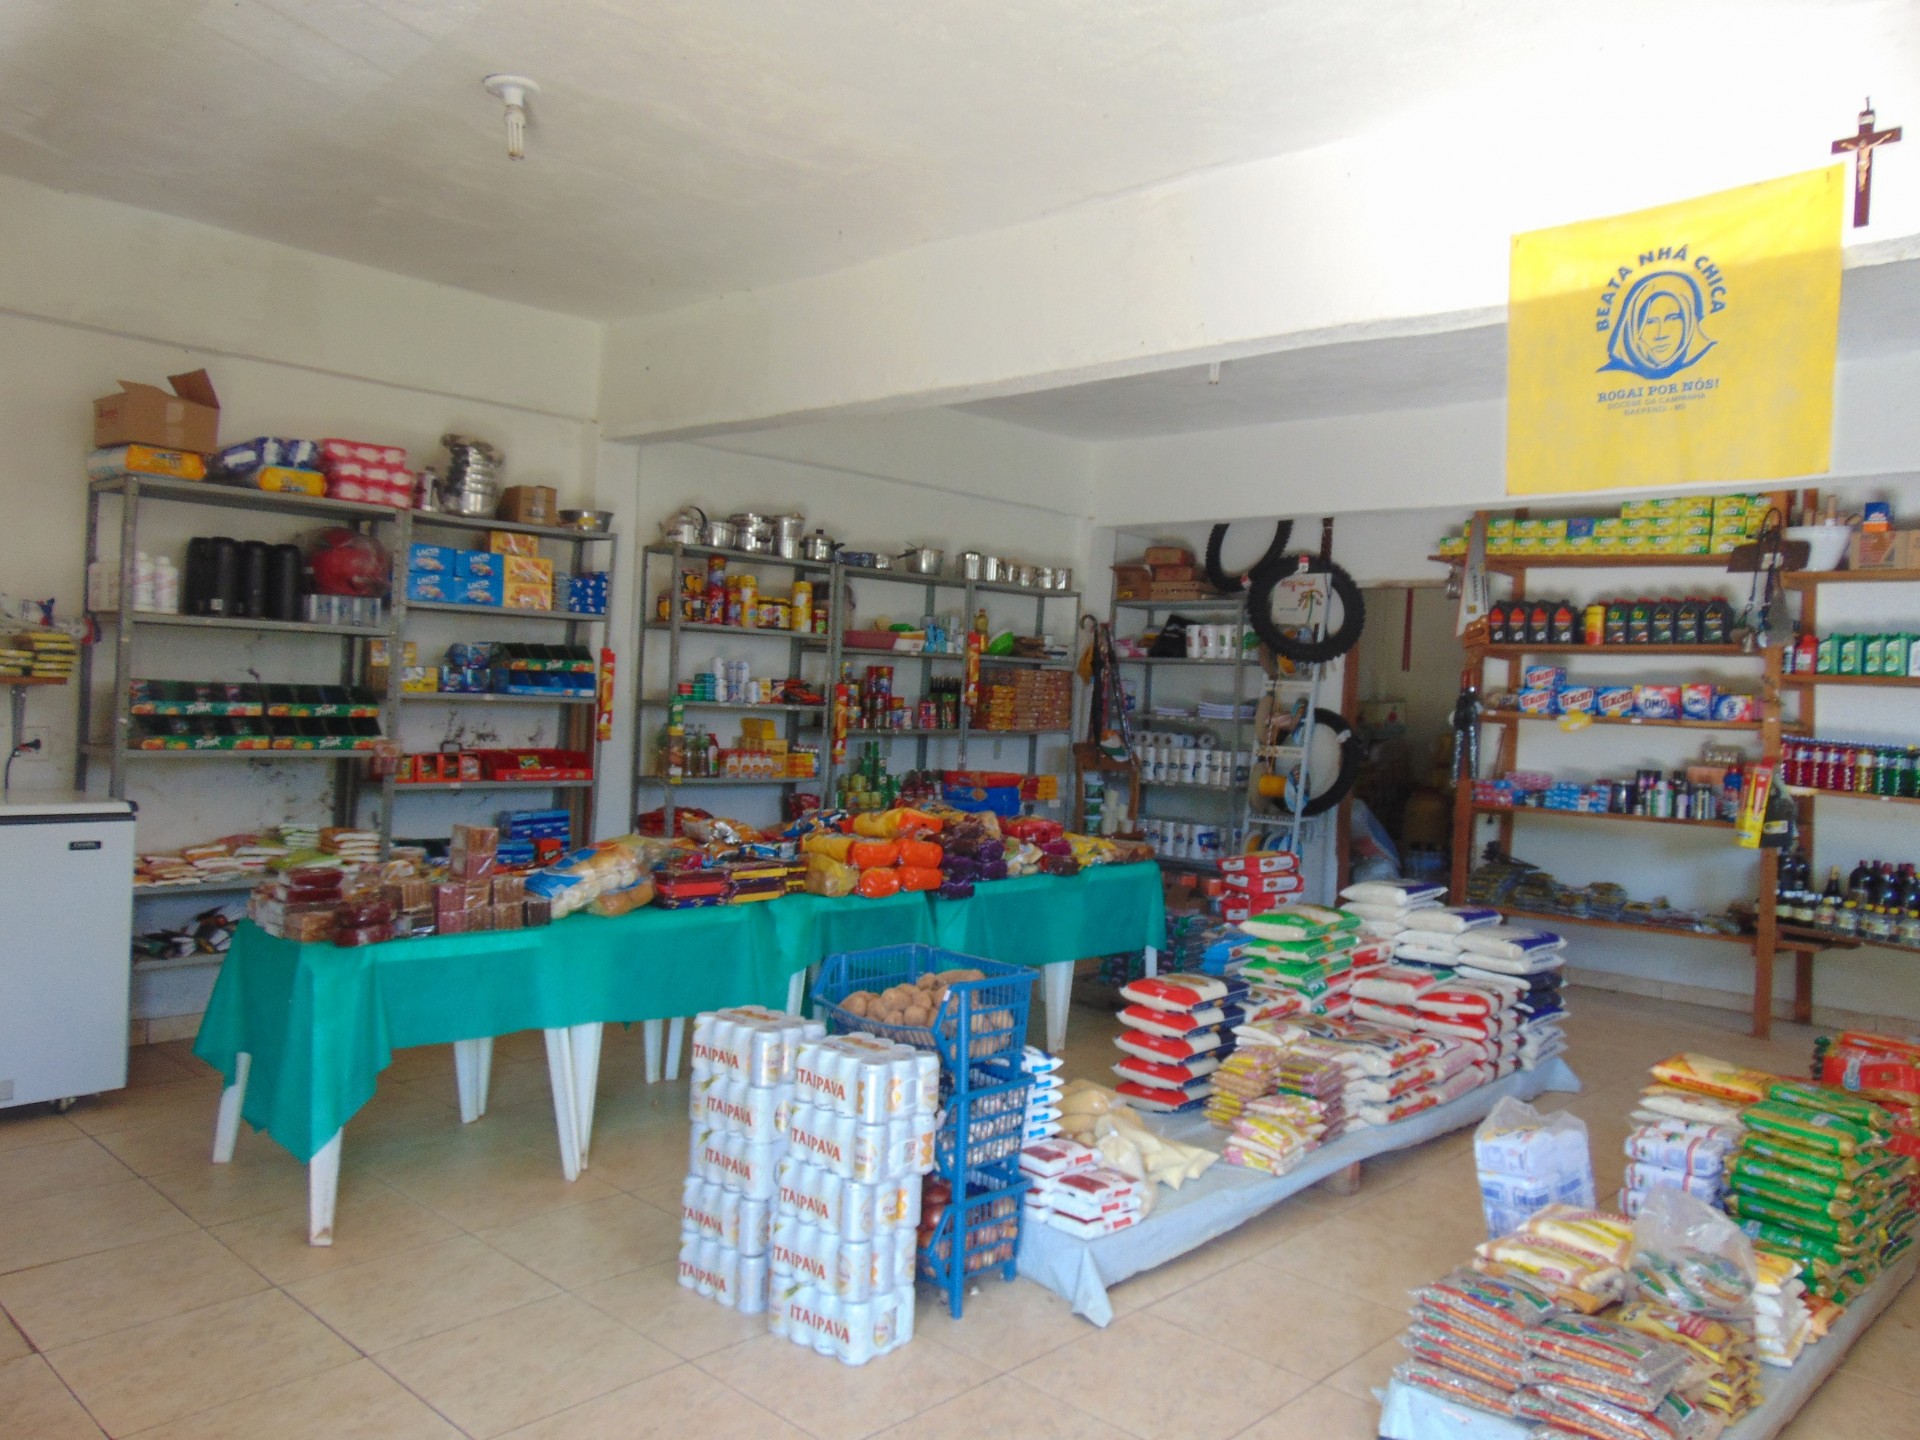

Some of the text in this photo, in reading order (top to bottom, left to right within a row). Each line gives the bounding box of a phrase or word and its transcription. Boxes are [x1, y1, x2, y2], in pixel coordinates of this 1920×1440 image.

[1596, 244, 1726, 332] BEATA NHÁ CHICA
[1597, 378, 1719, 402] ROGAI POR NÓS!
[1645, 698, 1667, 709] OMO
[707, 1096, 752, 1127] ITAIPAVA
[705, 1147, 751, 1180] ITAIPAVA
[790, 1303, 850, 1344] ITAIPAVA
